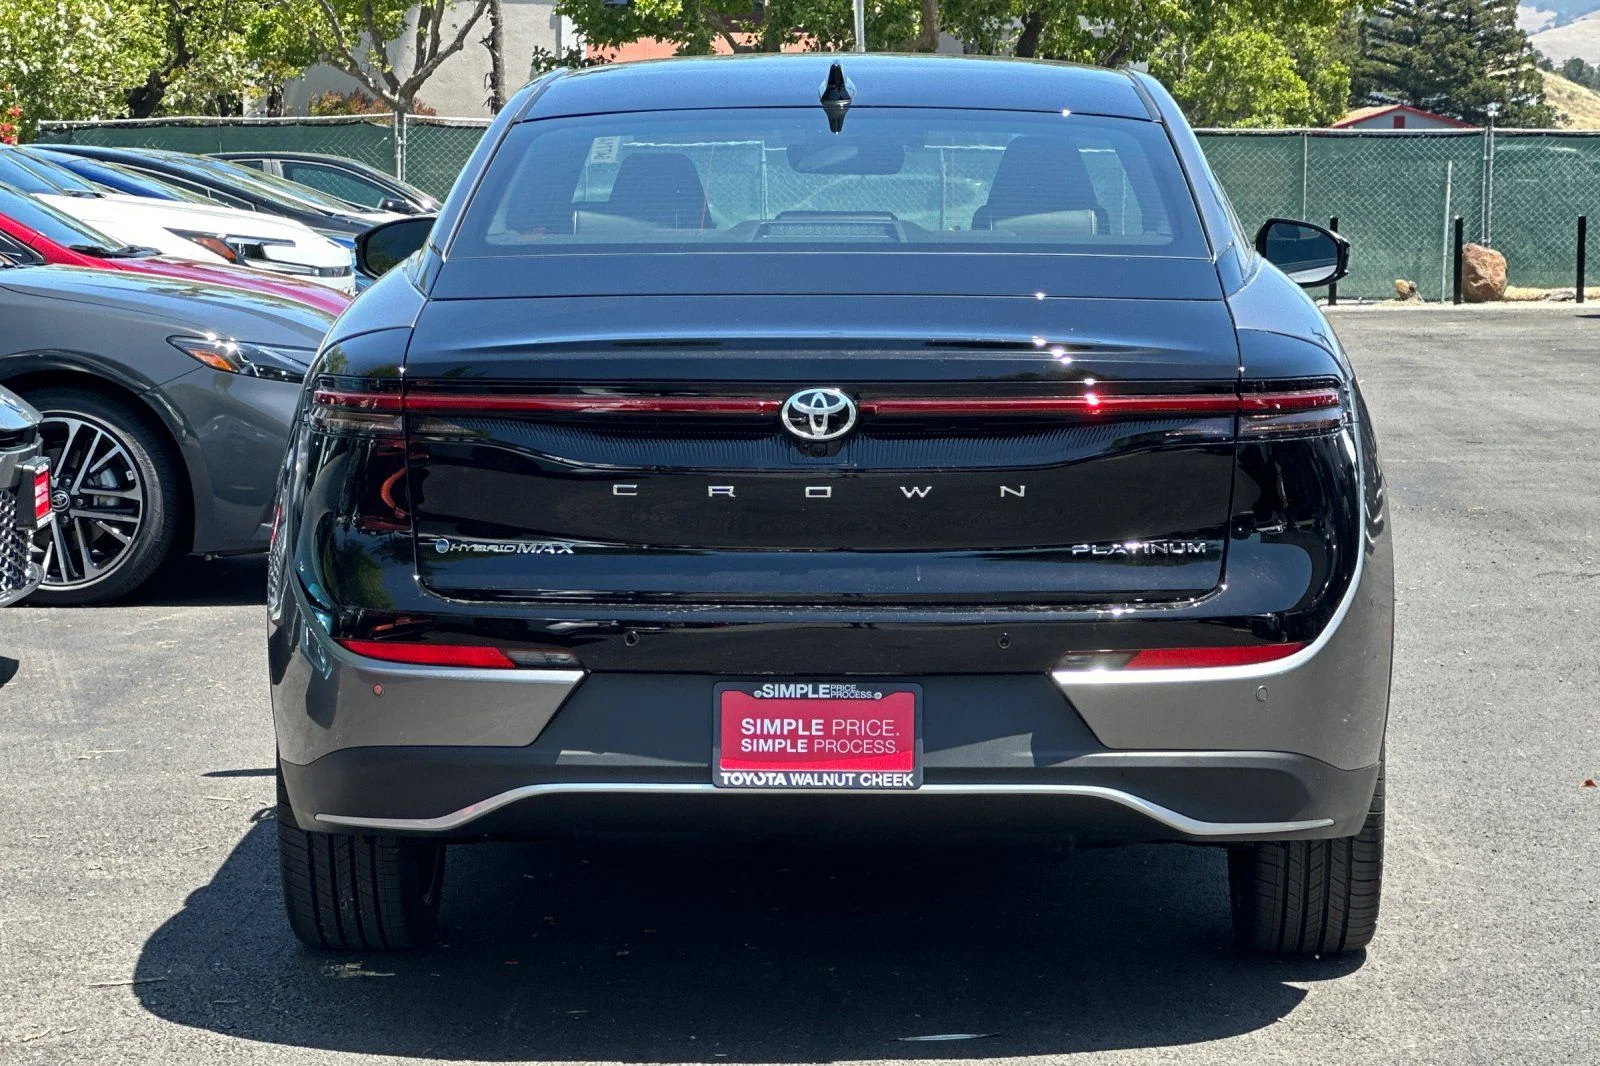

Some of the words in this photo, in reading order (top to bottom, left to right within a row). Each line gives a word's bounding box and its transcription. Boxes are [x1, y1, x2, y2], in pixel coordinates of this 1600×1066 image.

[612, 484, 1026, 498] CROWN
[1072, 542, 1206, 555] PLATINUM
[762, 683, 831, 699] SIMPLE
[741, 718, 824, 736] SIMPLE
[831, 719, 900, 737] PRICE.
[741, 738, 808, 753] SIMPLE
[814, 739, 900, 754] PROCESS.
[721, 772, 787, 786] TOYOTA
[789, 773, 856, 787] WALNUT
[859, 773, 914, 787] CREEK
